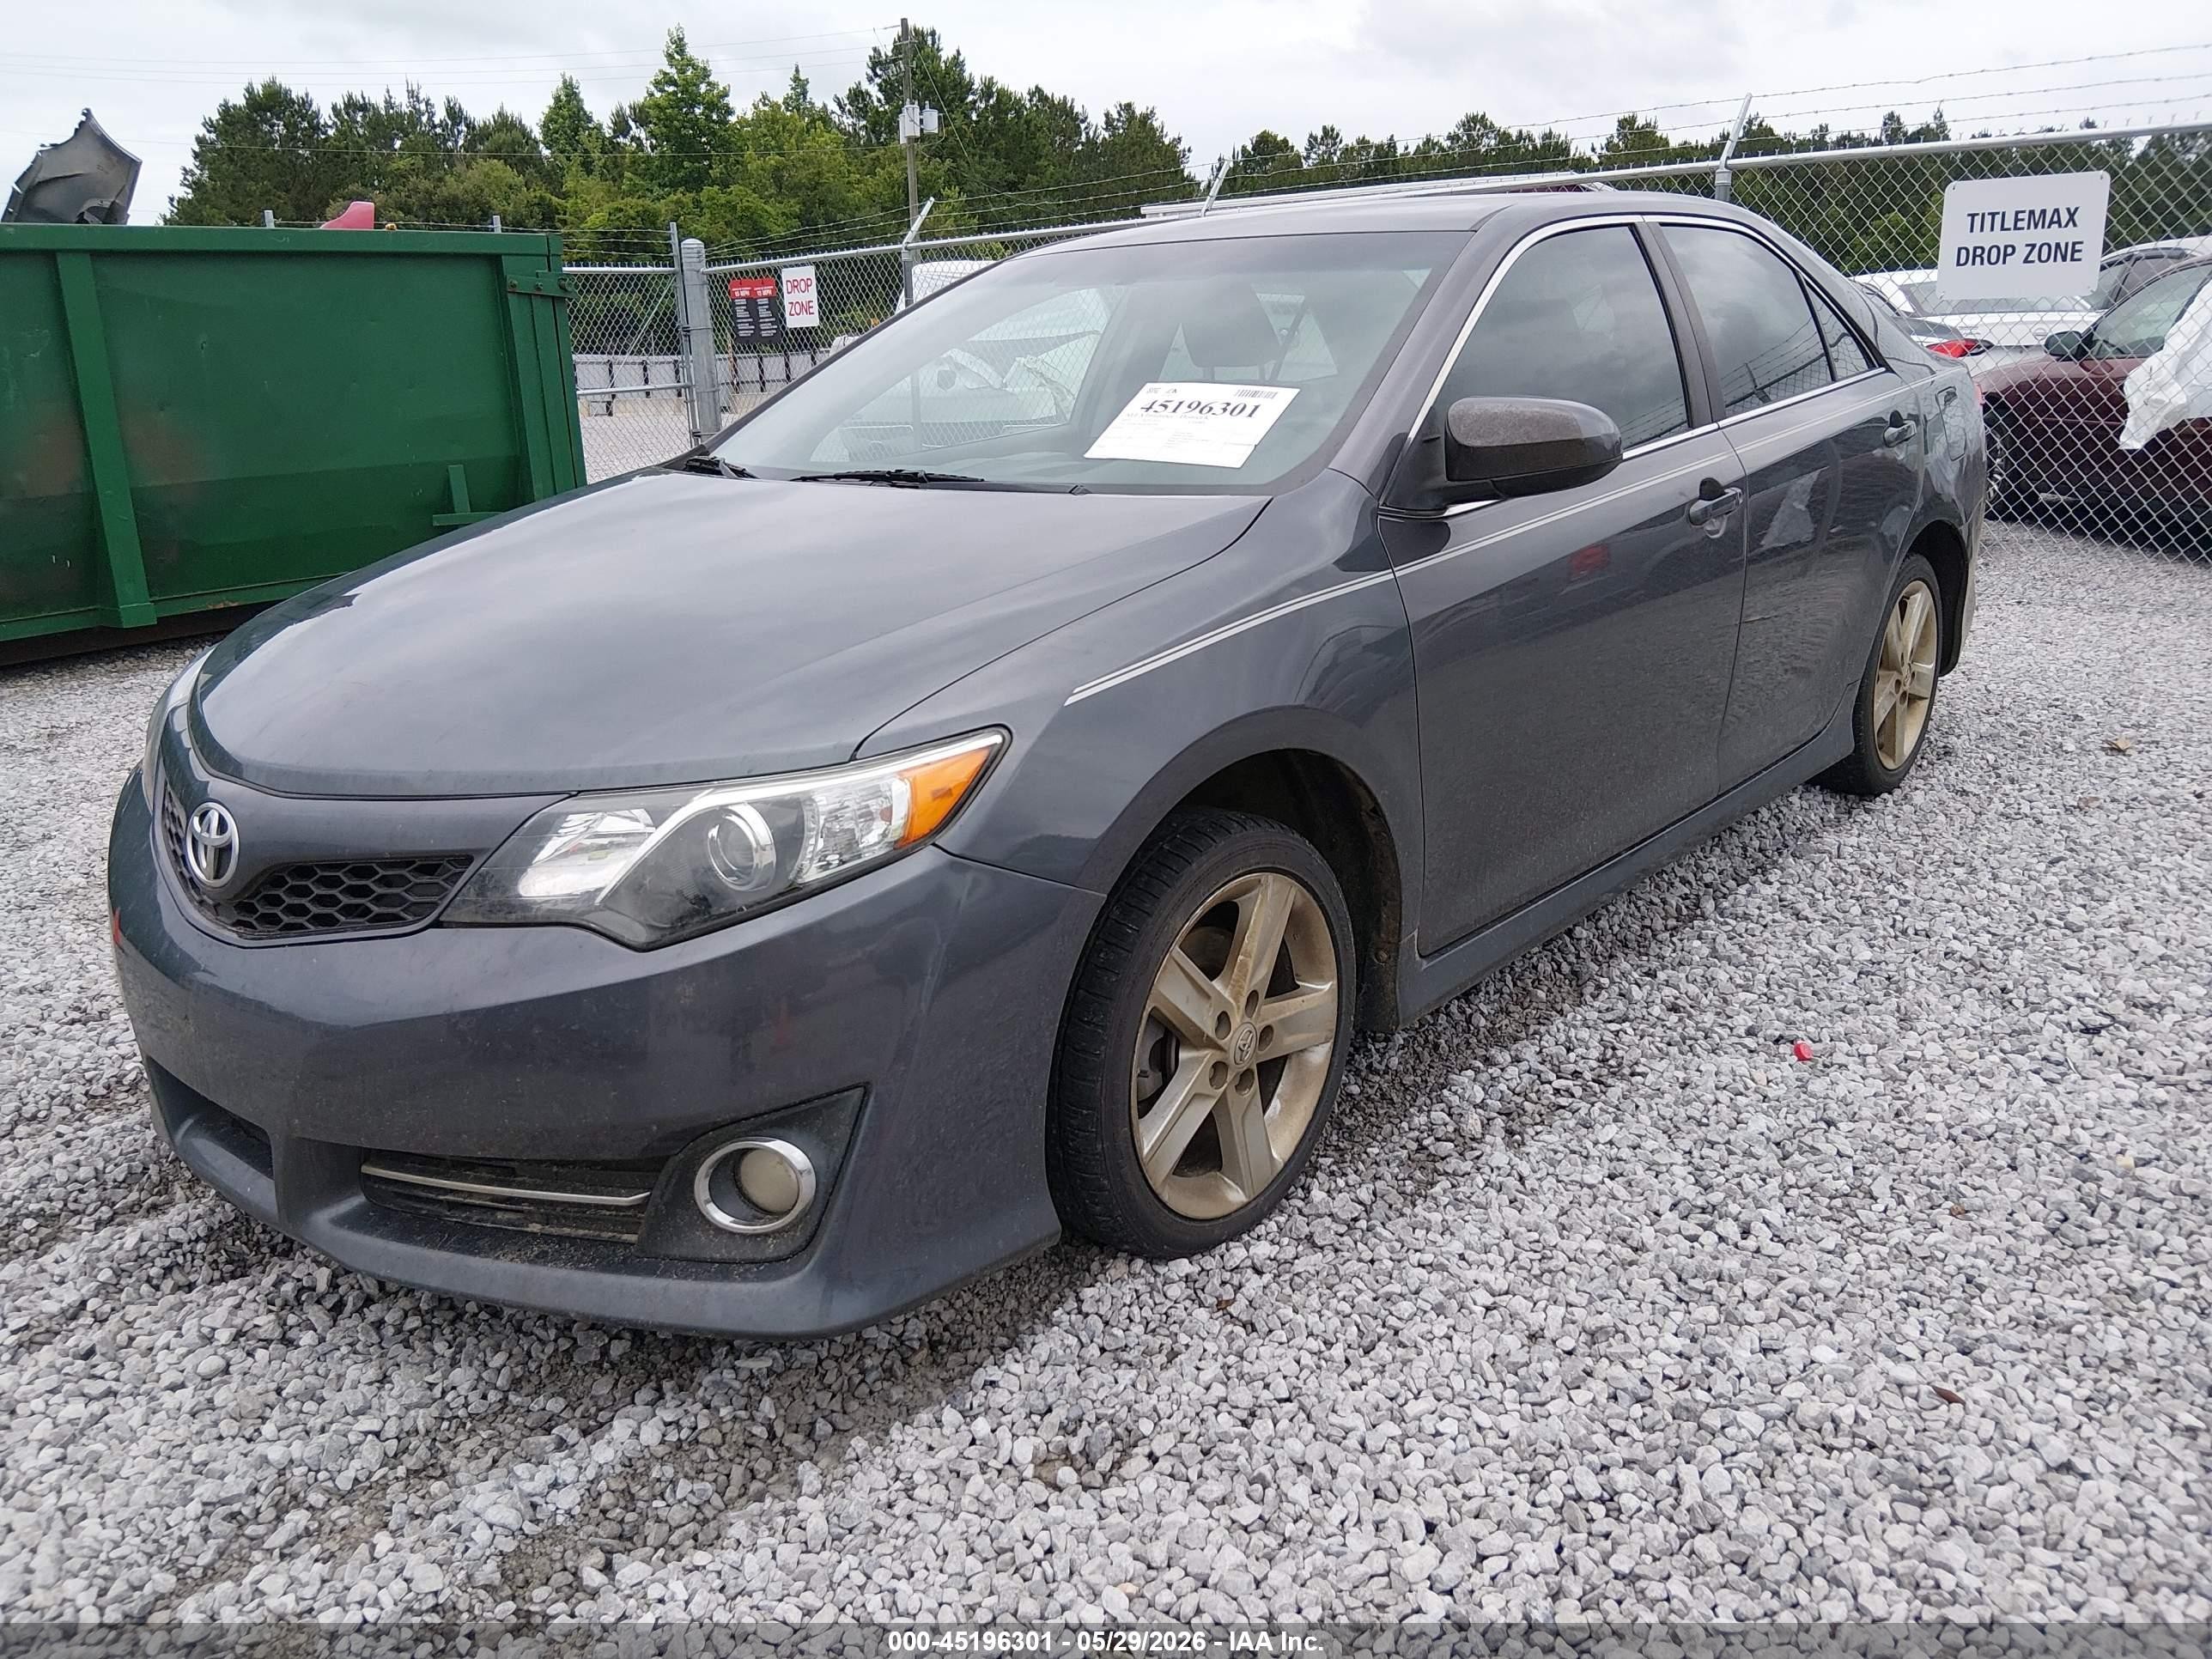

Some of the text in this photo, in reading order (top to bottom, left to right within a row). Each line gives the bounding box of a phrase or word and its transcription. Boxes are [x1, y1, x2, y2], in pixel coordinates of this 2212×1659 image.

[1967, 206, 2080, 234] TITLEMAX
[1955, 240, 2084, 267] DROP ZONE
[786, 277, 812, 295] DROP
[788, 300, 814, 317] ZONE
[1140, 398, 1262, 419] 45196301
